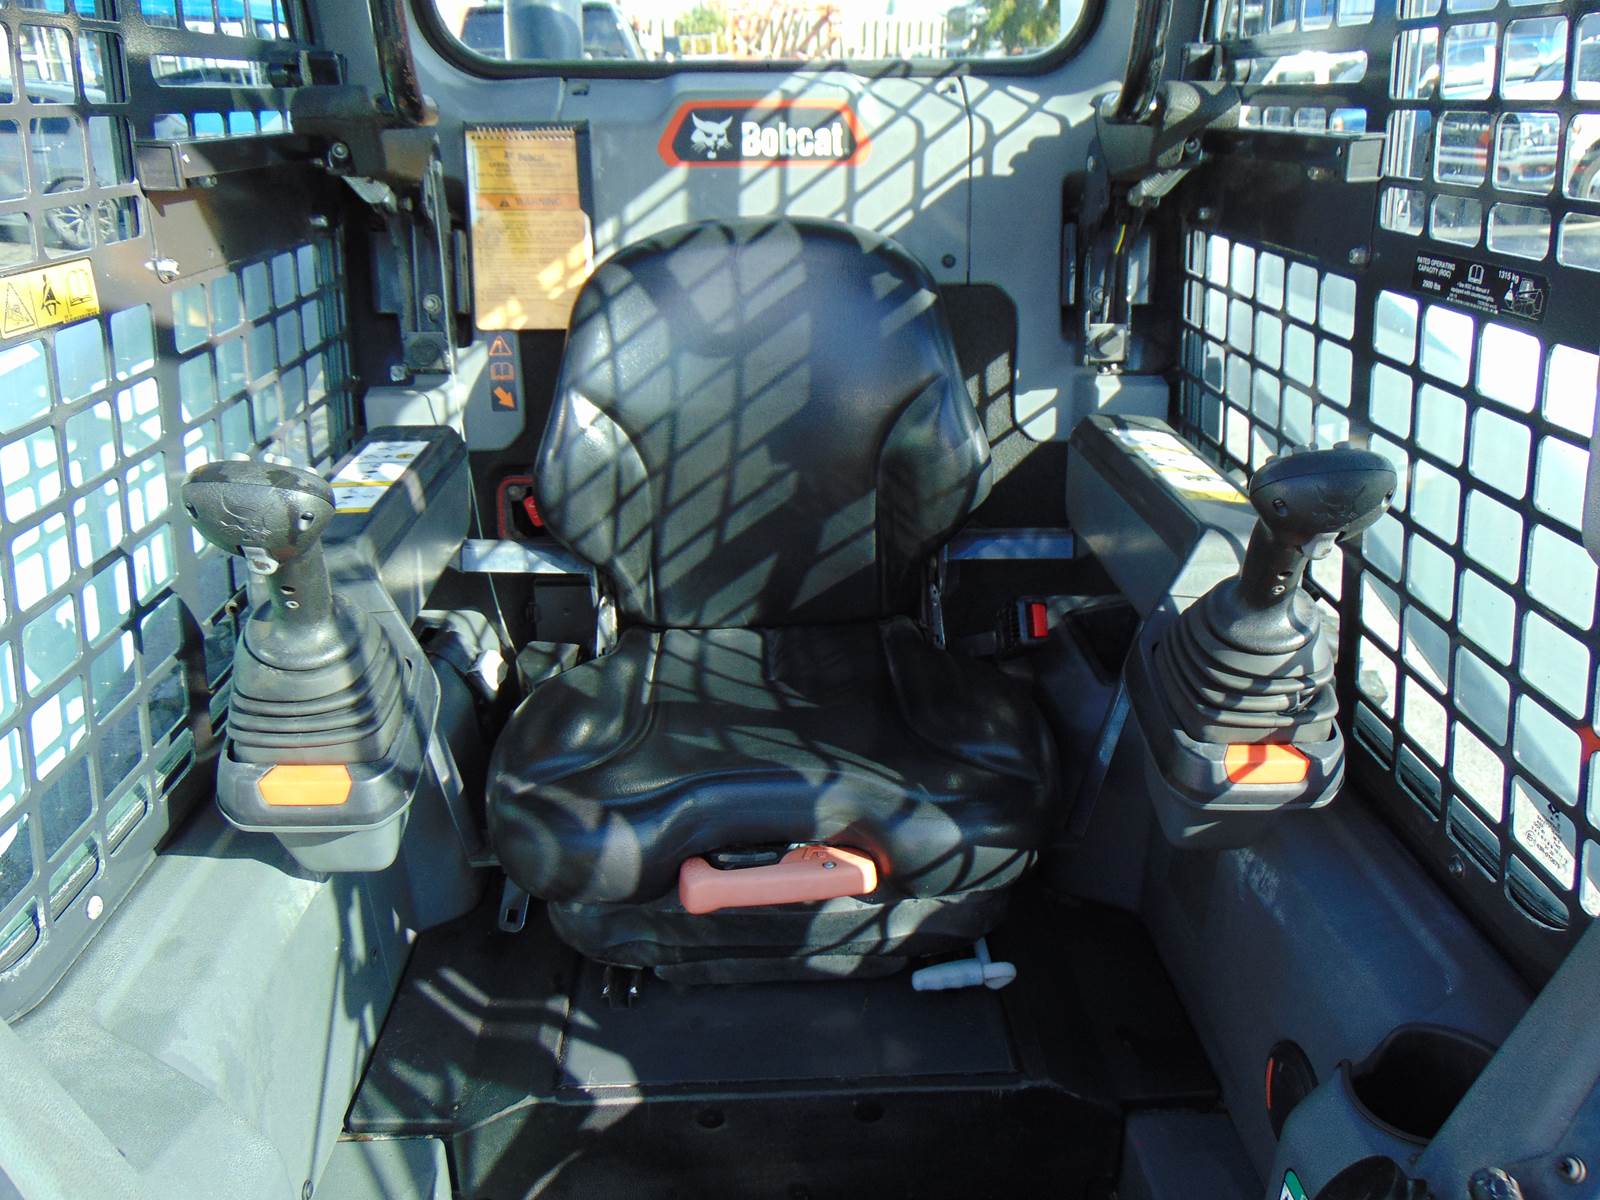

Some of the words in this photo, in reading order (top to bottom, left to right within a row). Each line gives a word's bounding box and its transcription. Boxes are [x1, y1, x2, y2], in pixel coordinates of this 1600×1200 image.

[741, 121, 844, 157] Bobcat
[1498, 270, 1511, 281] 1315
[1511, 273, 1520, 285] kg
